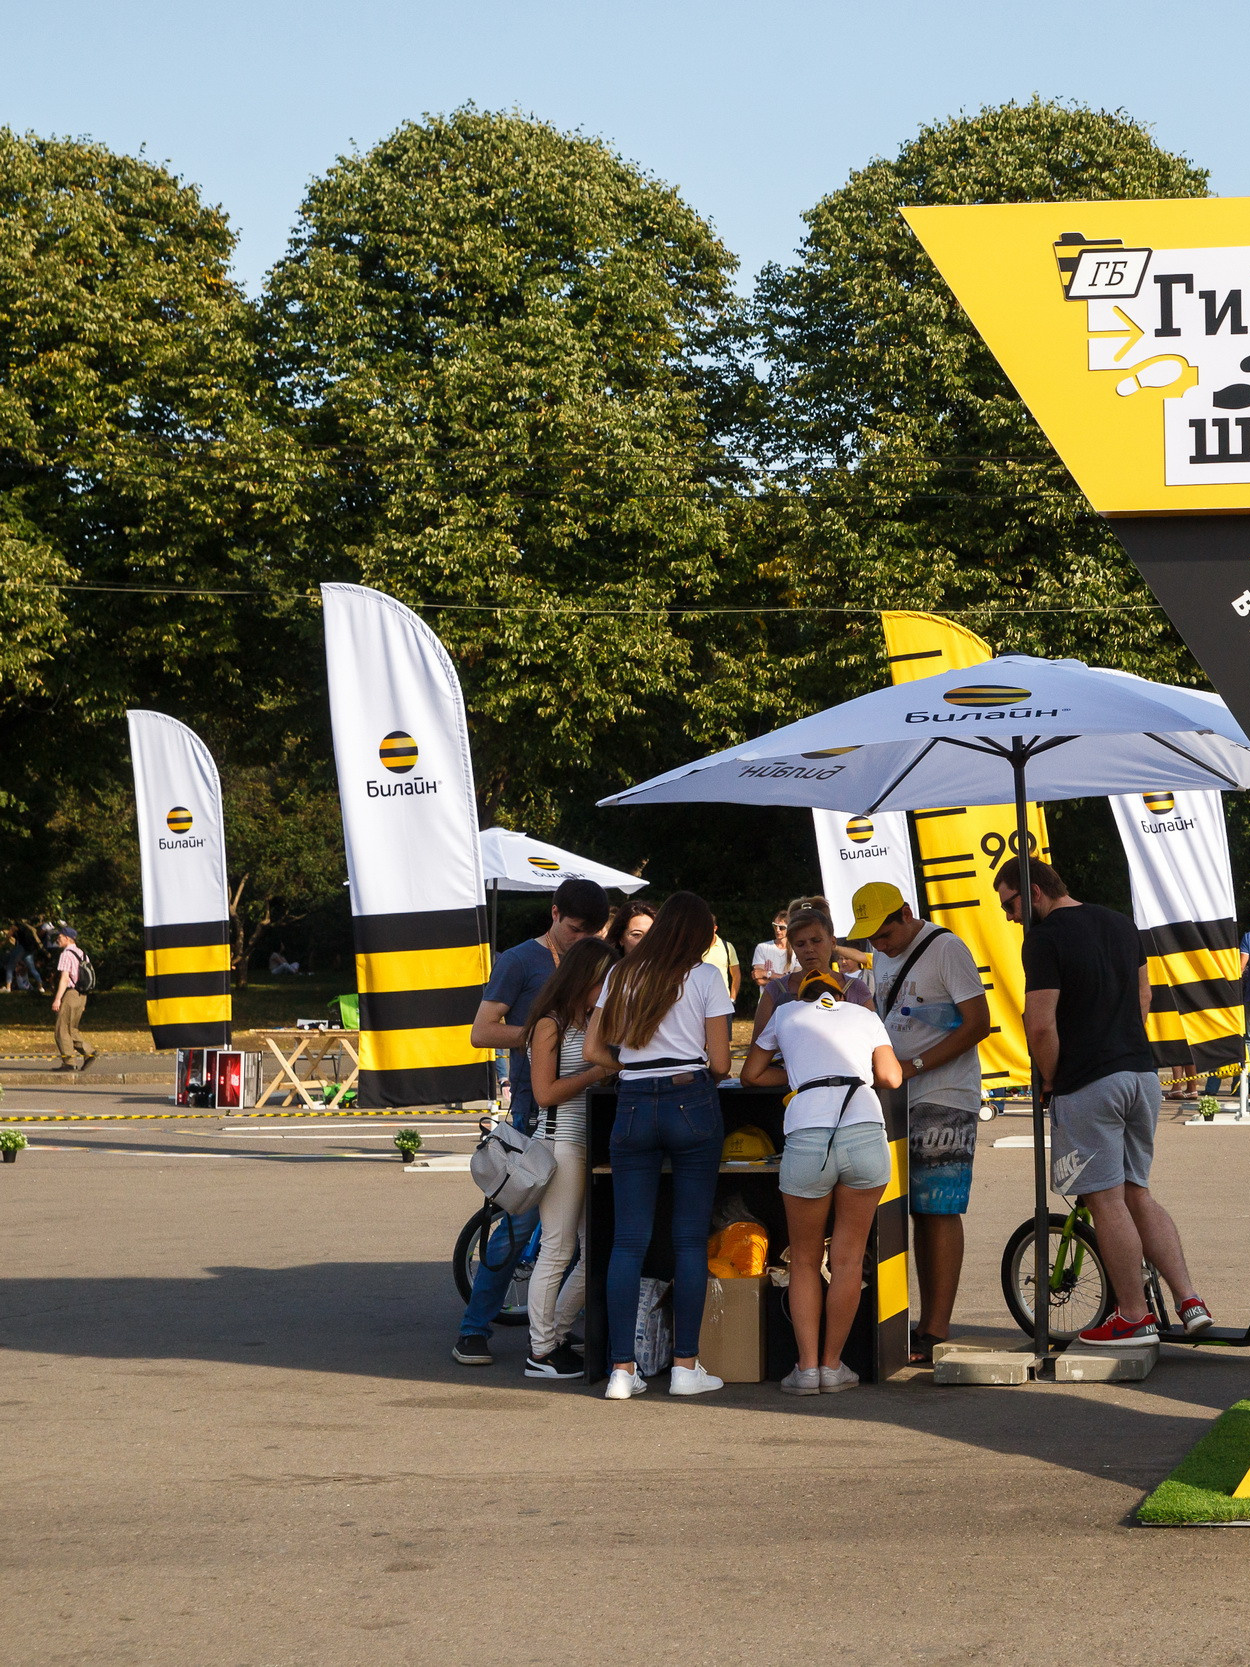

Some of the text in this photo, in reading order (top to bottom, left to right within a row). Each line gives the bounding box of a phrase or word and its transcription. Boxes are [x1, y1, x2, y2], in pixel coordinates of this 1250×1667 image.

[1088, 261, 1128, 287] ГБ
[905, 707, 1058, 723] Билайн
[367, 777, 437, 798] Билайн
[1141, 816, 1194, 833] Билайн
[159, 836, 204, 850] Билайн
[840, 845, 887, 860] Билайн
[1053, 1149, 1082, 1183] NIKE
[1185, 1306, 1203, 1319] NIKE
